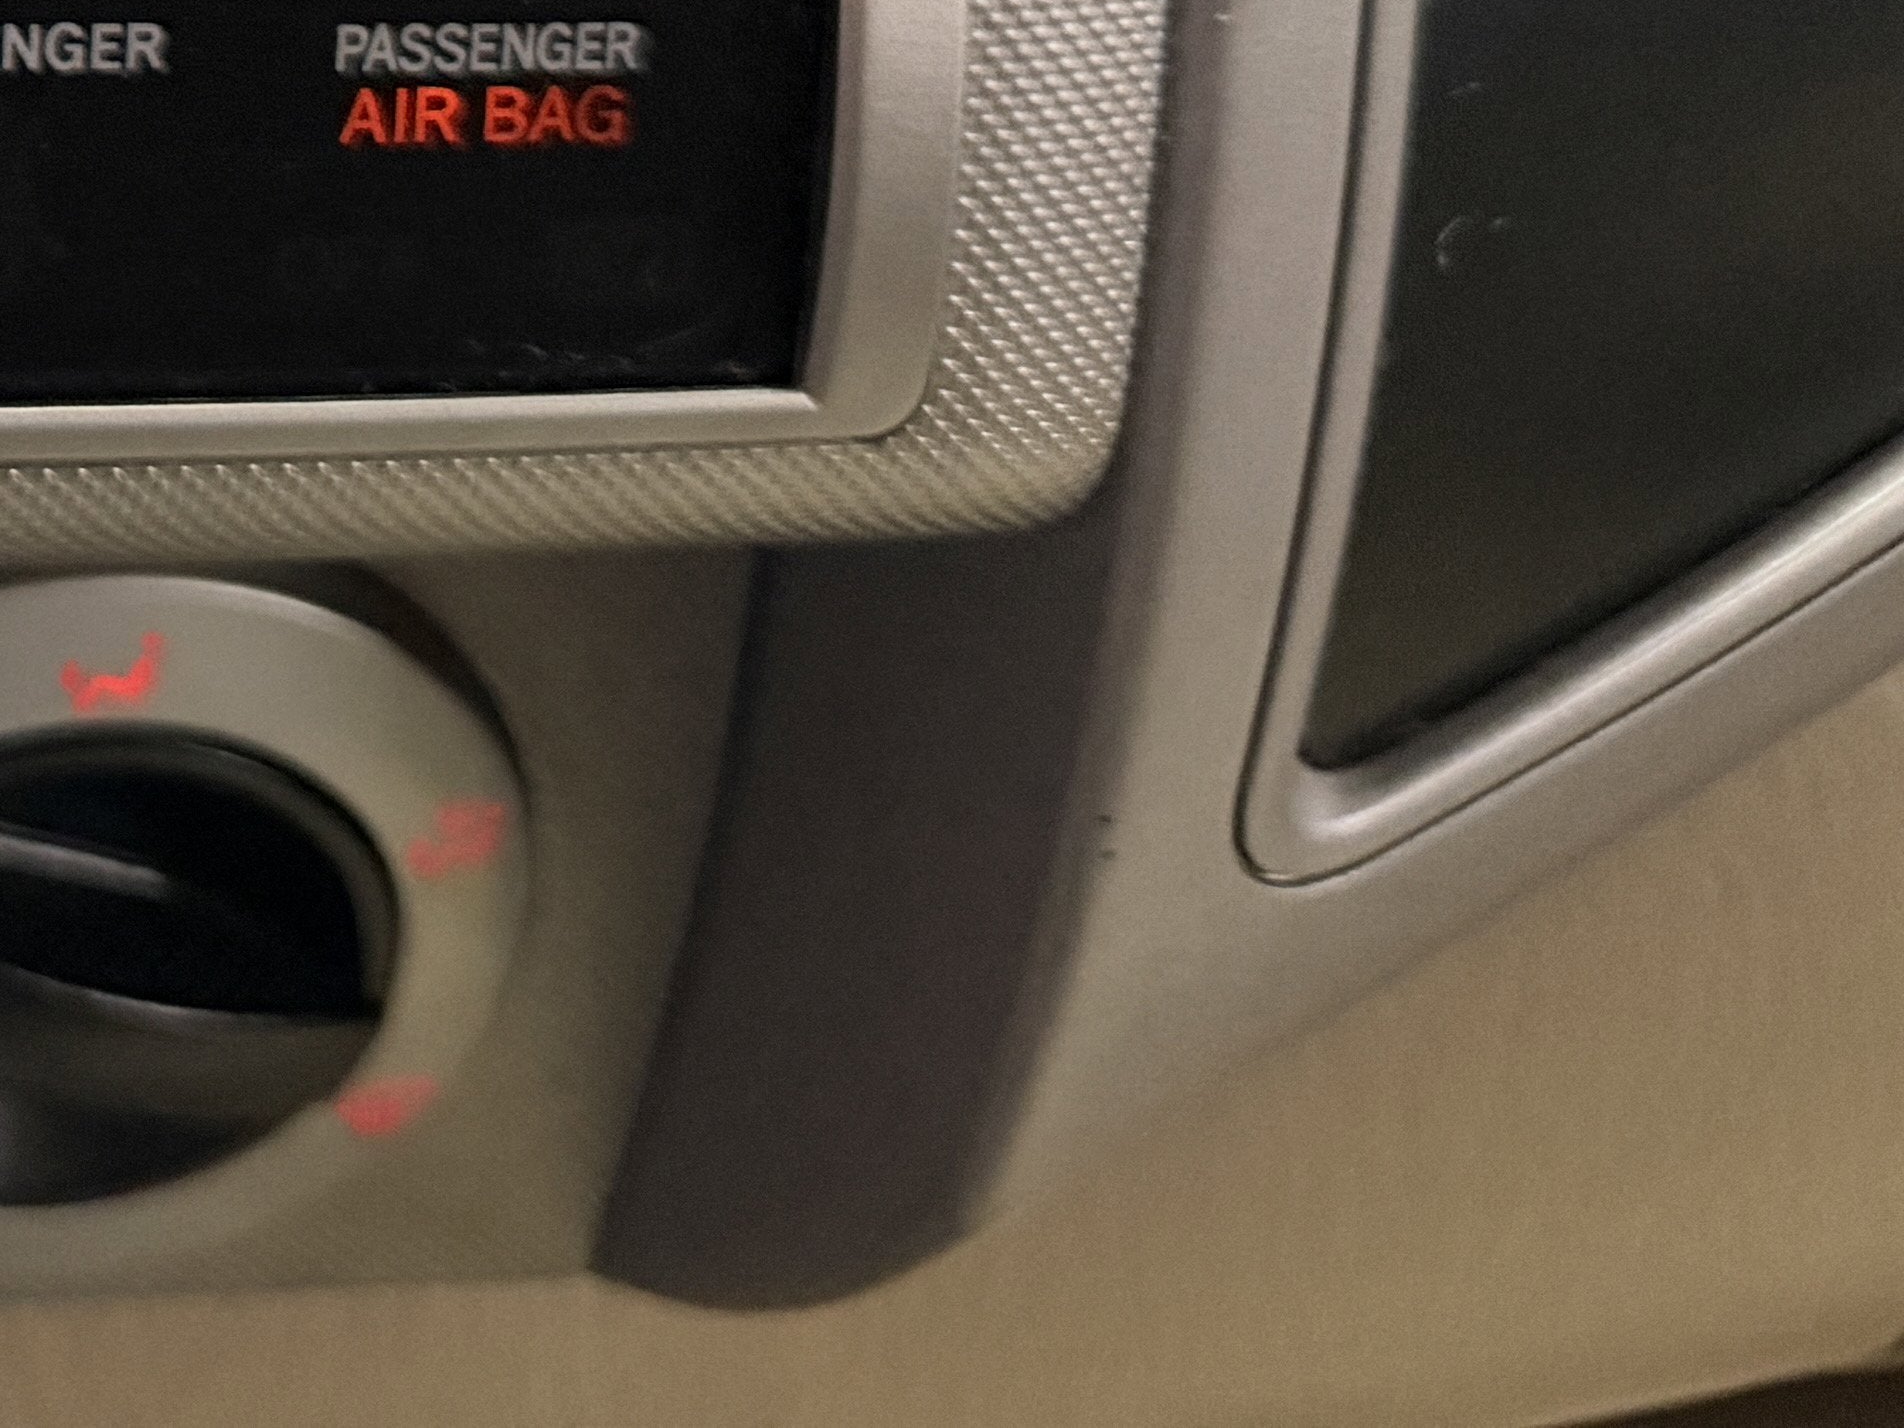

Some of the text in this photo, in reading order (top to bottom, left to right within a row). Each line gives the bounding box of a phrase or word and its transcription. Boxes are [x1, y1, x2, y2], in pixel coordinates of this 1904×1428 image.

[334, 21, 645, 72] PASSENGER
[338, 84, 630, 145] AIR BAG
